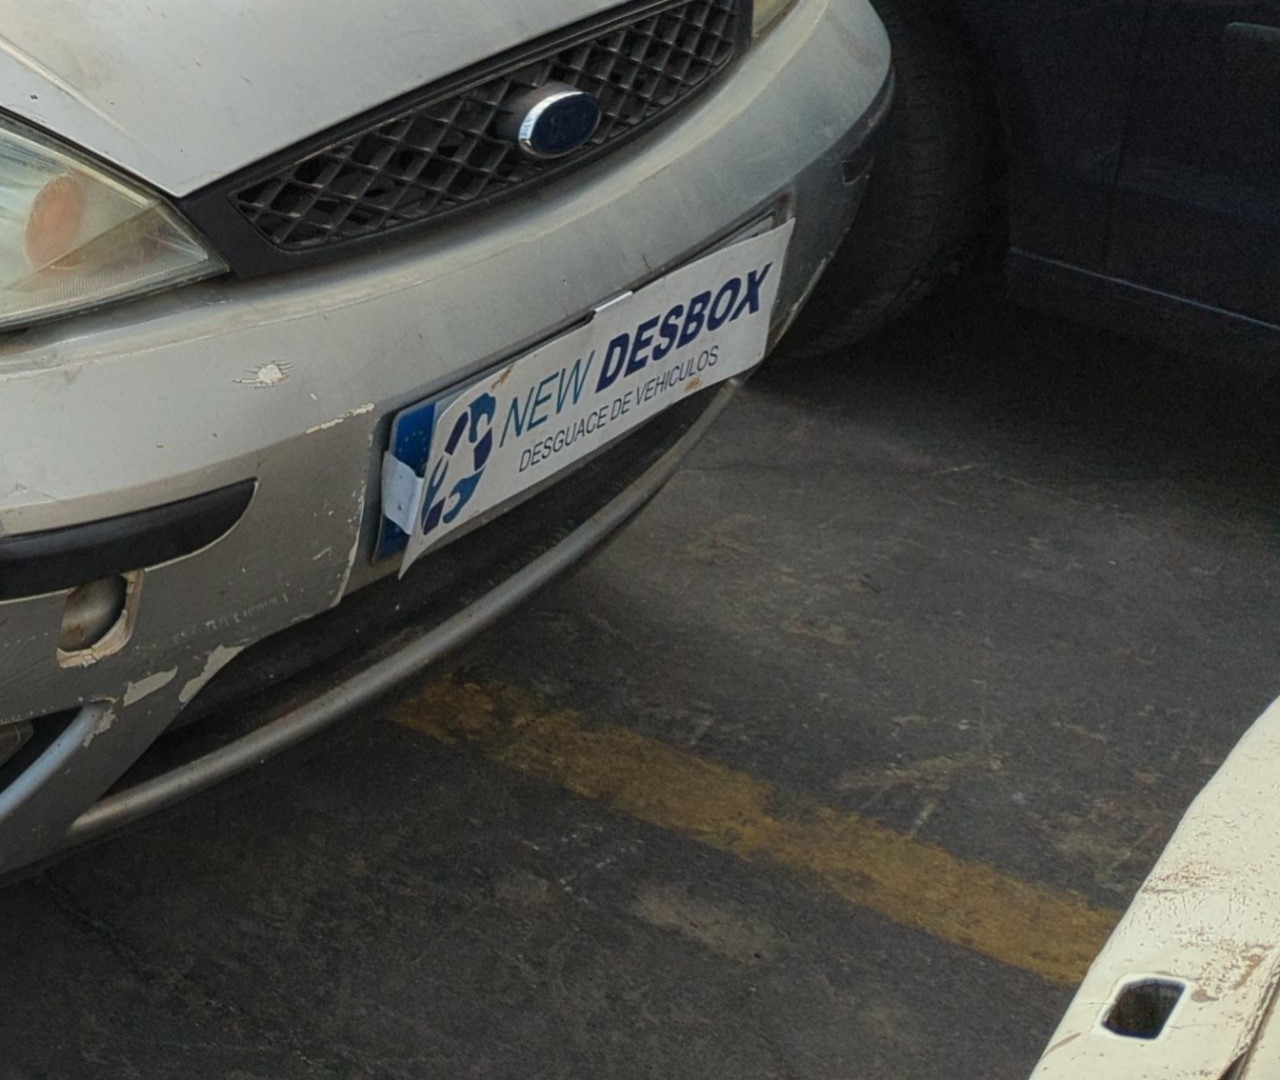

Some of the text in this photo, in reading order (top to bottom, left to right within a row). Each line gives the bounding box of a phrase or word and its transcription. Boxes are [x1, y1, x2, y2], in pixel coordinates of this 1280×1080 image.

[498, 261, 774, 448] NEW DESBOX
[518, 345, 719, 473] DESGUACE DE VEHICULOS
